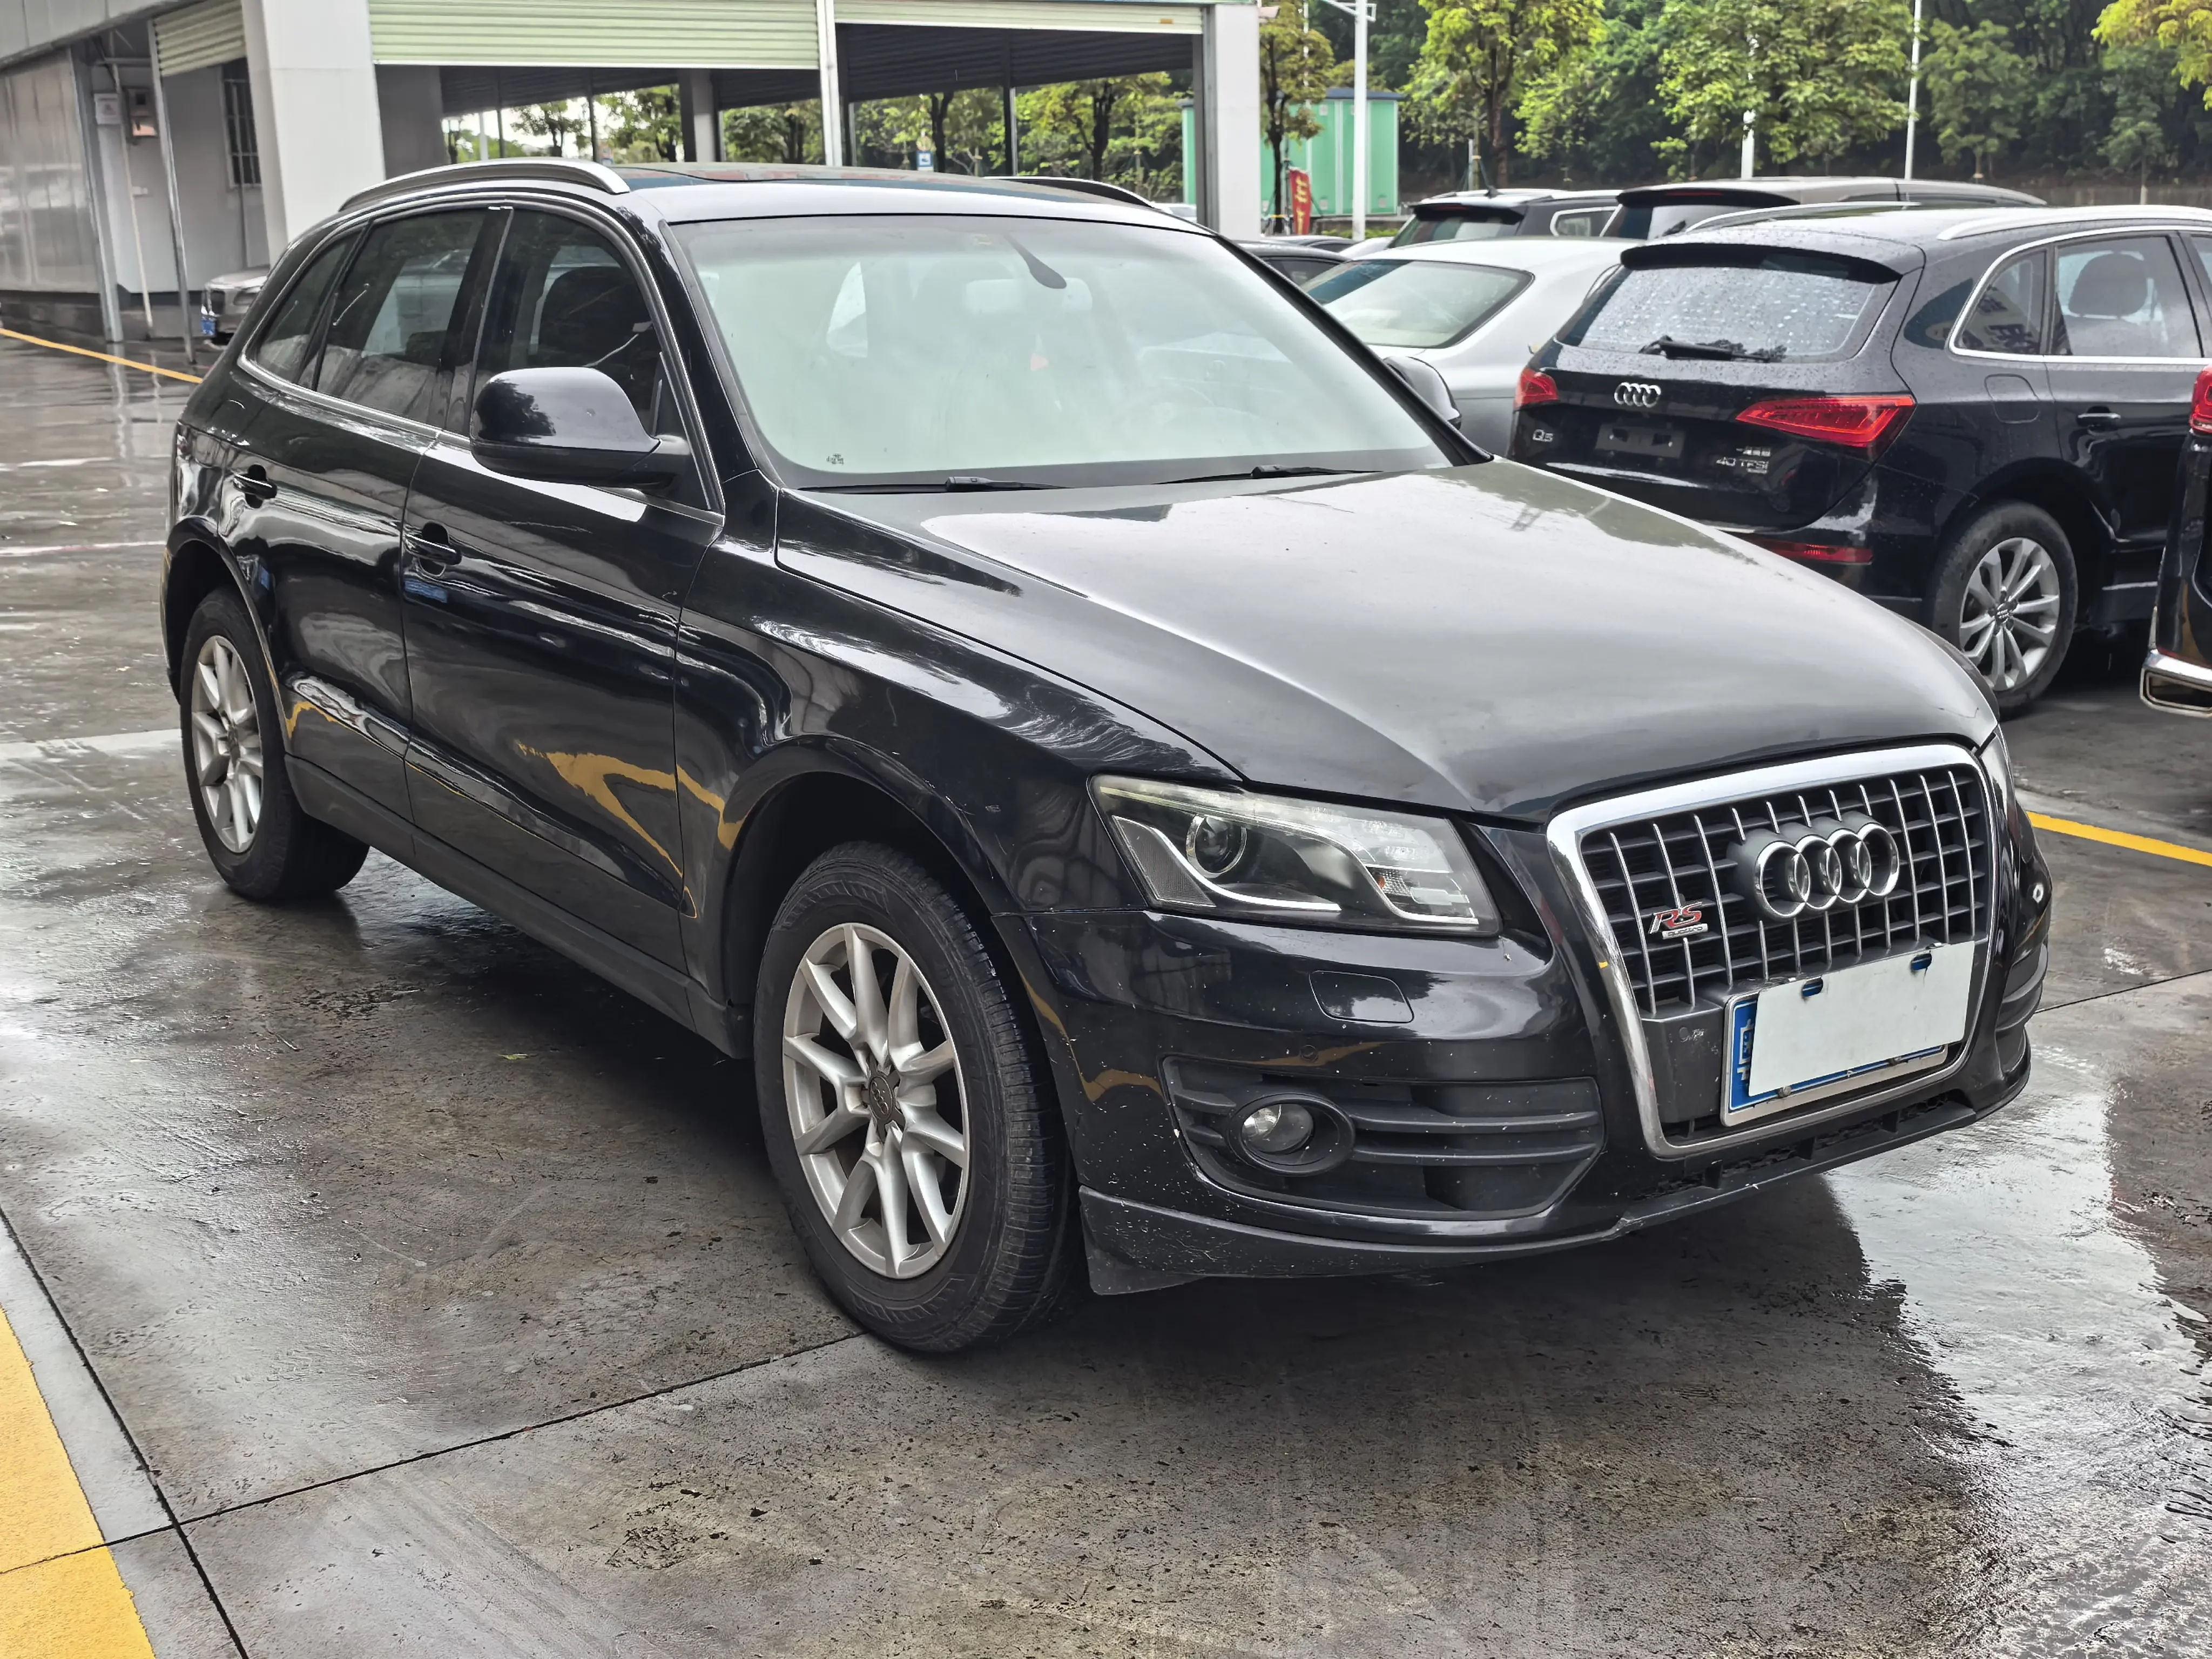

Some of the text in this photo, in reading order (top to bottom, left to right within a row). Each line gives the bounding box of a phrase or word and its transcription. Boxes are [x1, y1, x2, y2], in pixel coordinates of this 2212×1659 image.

[1533, 429, 1553, 442] Q5
[1716, 457, 1769, 469] 40 TFSI
[1648, 901, 1702, 934] RS
